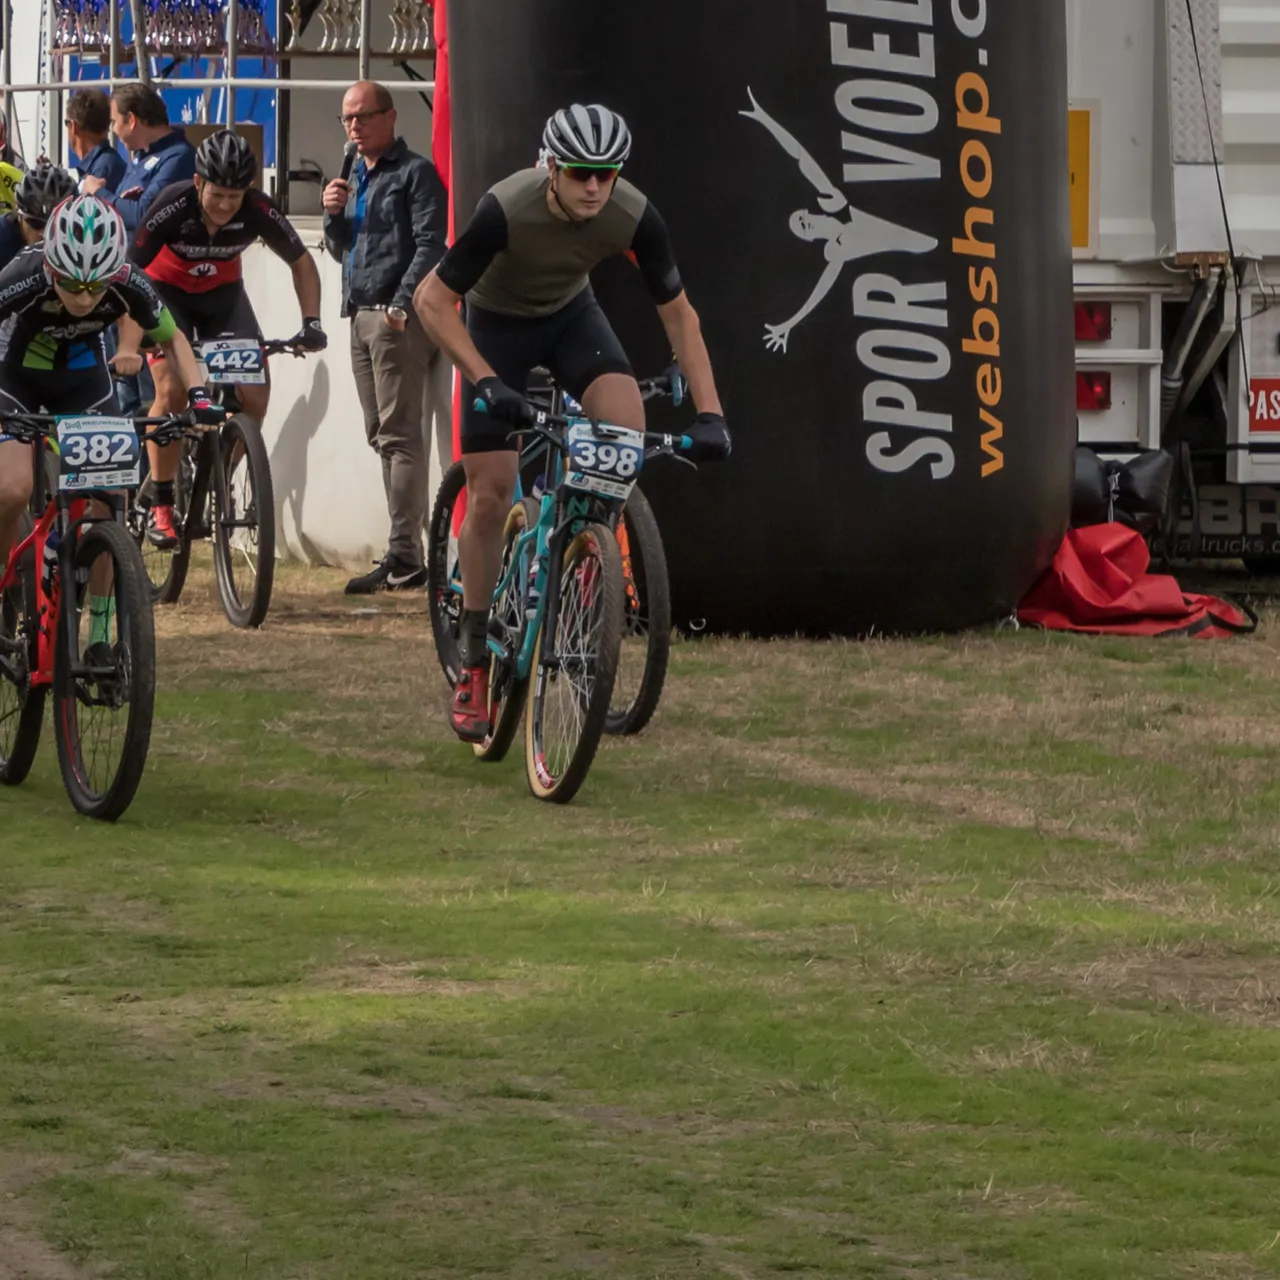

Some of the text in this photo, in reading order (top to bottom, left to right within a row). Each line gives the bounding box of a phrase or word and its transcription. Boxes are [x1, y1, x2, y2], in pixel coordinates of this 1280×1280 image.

[209, 350, 260, 370] 442
[64, 433, 134, 466] 382
[573, 441, 639, 477] 398
